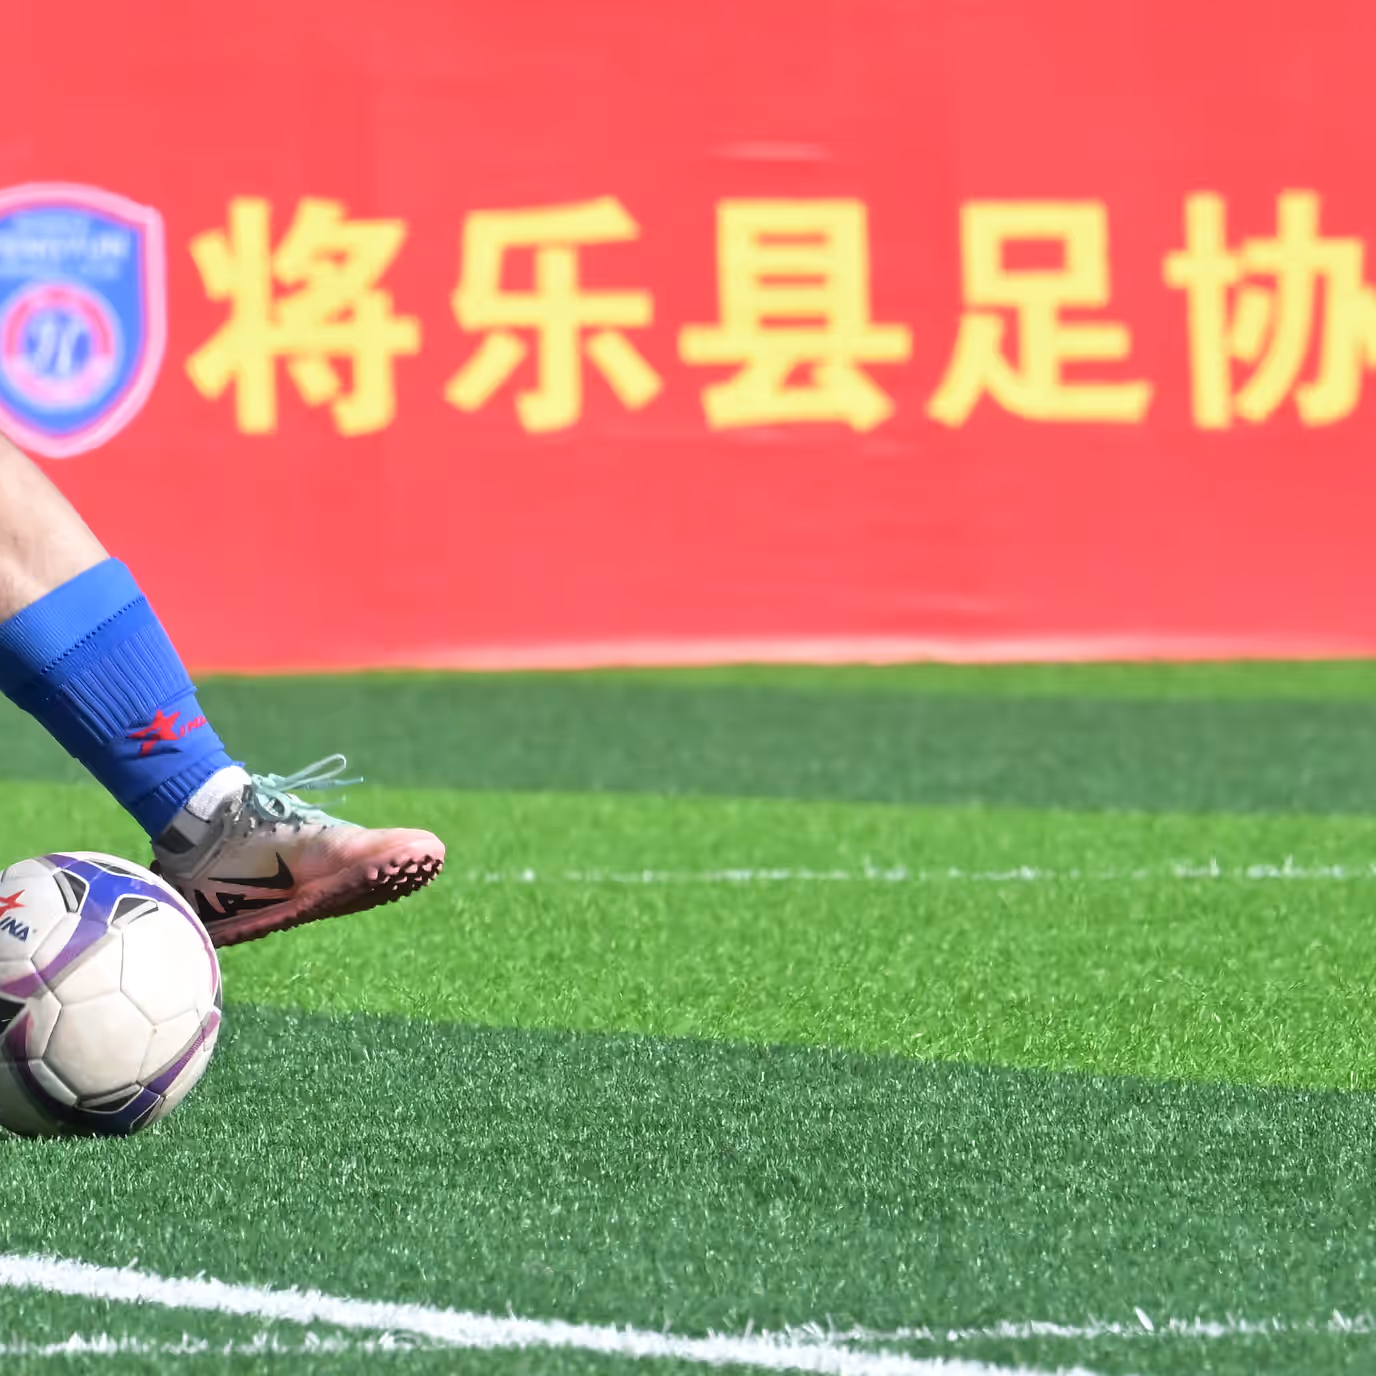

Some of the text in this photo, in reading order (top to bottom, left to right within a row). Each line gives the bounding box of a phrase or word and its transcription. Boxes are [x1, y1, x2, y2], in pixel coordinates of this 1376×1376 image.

[185, 188, 1376, 438] 将乐县足协
